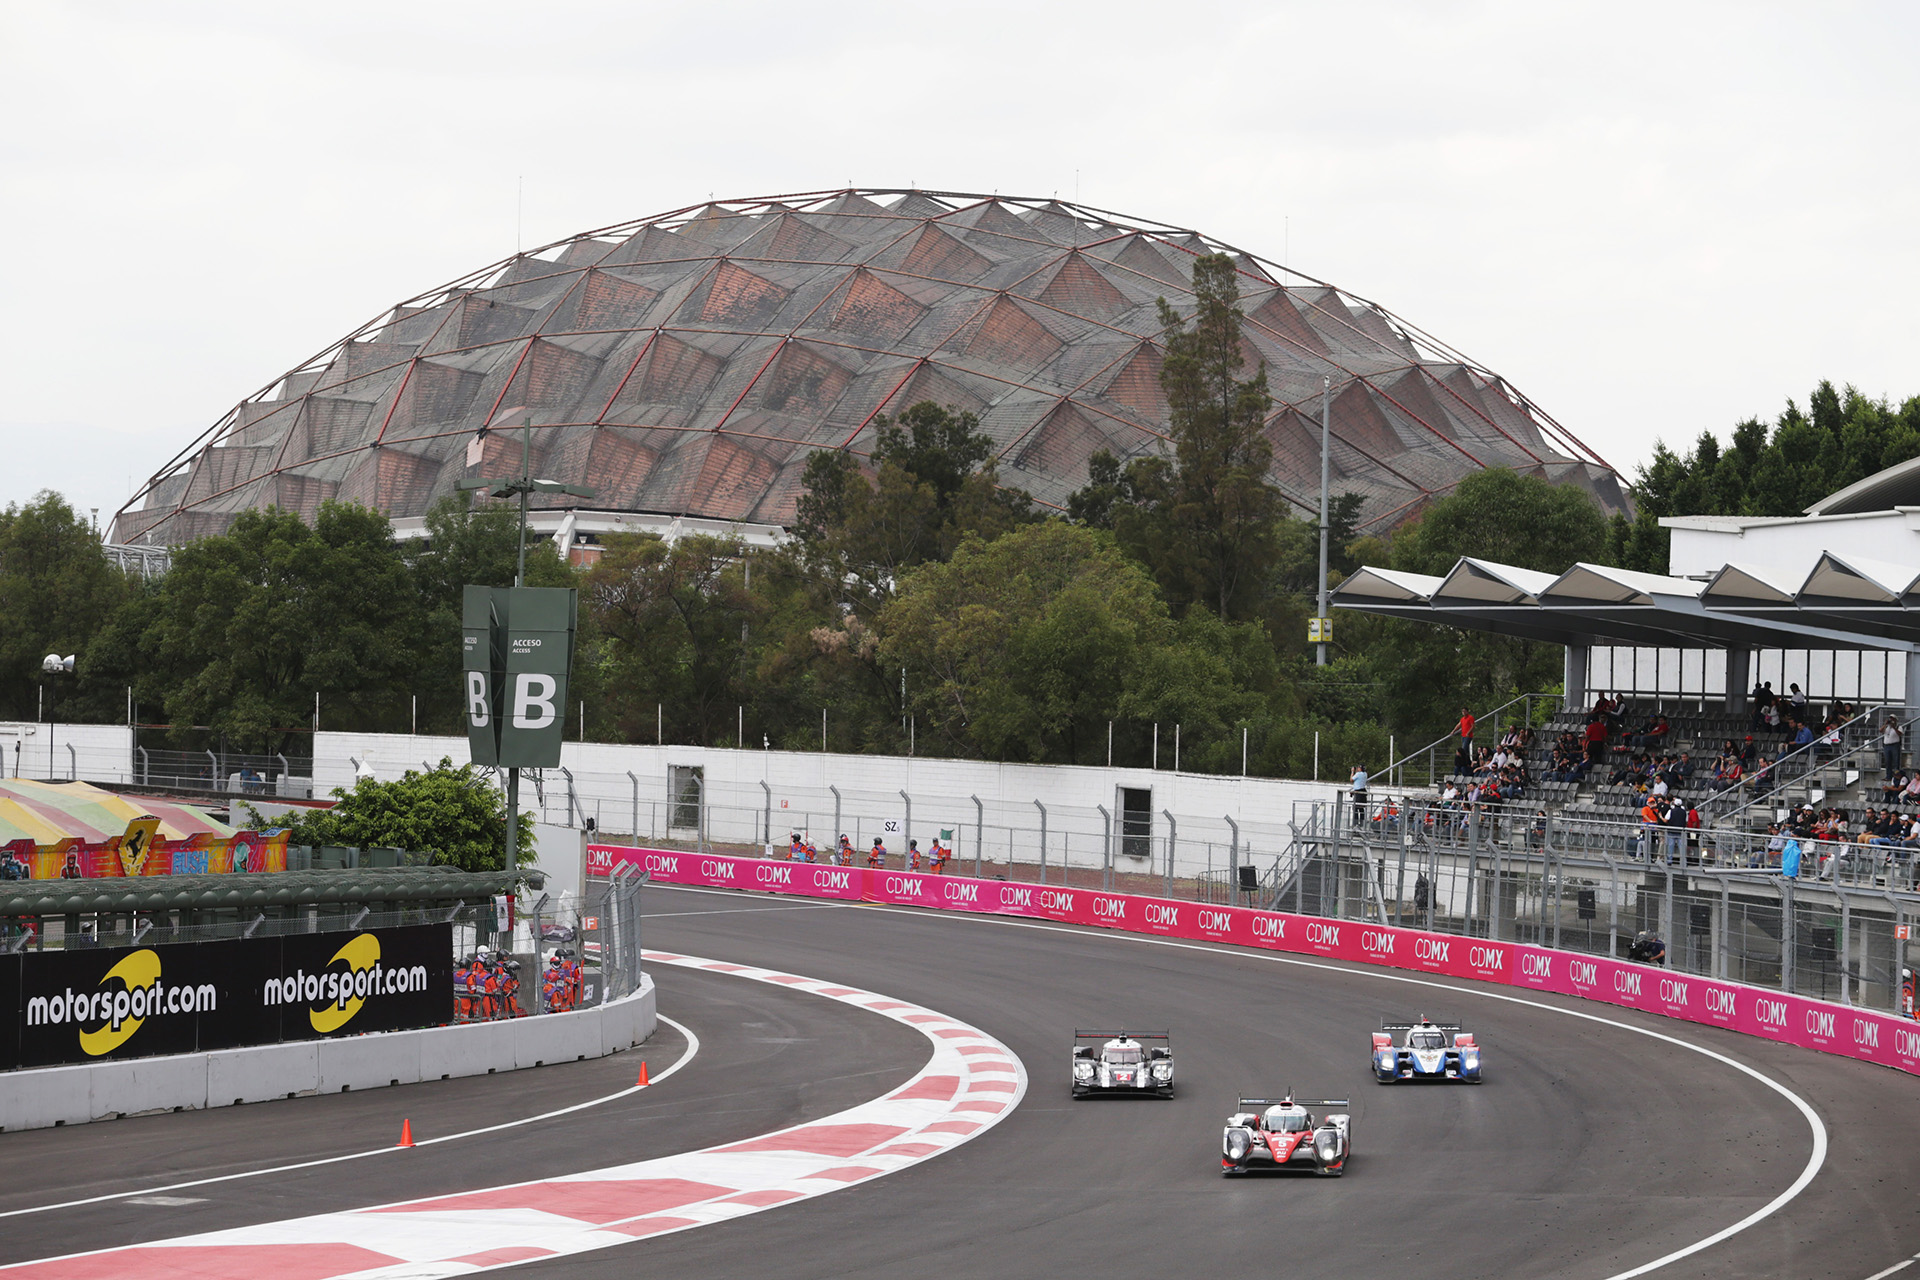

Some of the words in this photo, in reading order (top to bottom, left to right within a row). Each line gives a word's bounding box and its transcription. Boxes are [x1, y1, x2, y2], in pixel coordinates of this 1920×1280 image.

[512, 639, 541, 647] ACCESO
[468, 671, 488, 727] B
[513, 673, 556, 729] B
[173, 851, 208, 875] RUSH
[588, 850, 612, 867] DMX
[645, 855, 678, 873] CDMX
[702, 860, 734, 879] CDMX
[756, 865, 791, 883] CDMX
[814, 870, 849, 889] CDMX
[886, 877, 922, 896] CDMX
[944, 882, 978, 902] CDMX
[1000, 887, 1031, 906] CDMX
[1041, 891, 1073, 911] CDMX
[1093, 897, 1126, 918] CDMX
[588, 918, 594, 928] F
[1145, 904, 1178, 925] CDMX
[1198, 910, 1231, 931] CDMX
[1252, 916, 1286, 938] CDMX
[1306, 923, 1339, 946] CDMX
[1897, 927, 1906, 938] F
[1362, 931, 1395, 953] CDMX
[1415, 938, 1449, 962] CDMX
[1470, 946, 1503, 970] CDMX
[1522, 954, 1551, 977] CDMX
[1570, 960, 1597, 986] CDMX
[1614, 970, 1641, 995] CDMX
[264, 963, 427, 1011] motorsport.com
[1660, 979, 1688, 1005] CDMX
[27, 981, 216, 1032] motorsport.com
[1706, 988, 1736, 1015] CDMX
[1756, 998, 1787, 1026] CDMX
[1806, 1010, 1835, 1038] CDMX
[1854, 1018, 1878, 1048] CDMX
